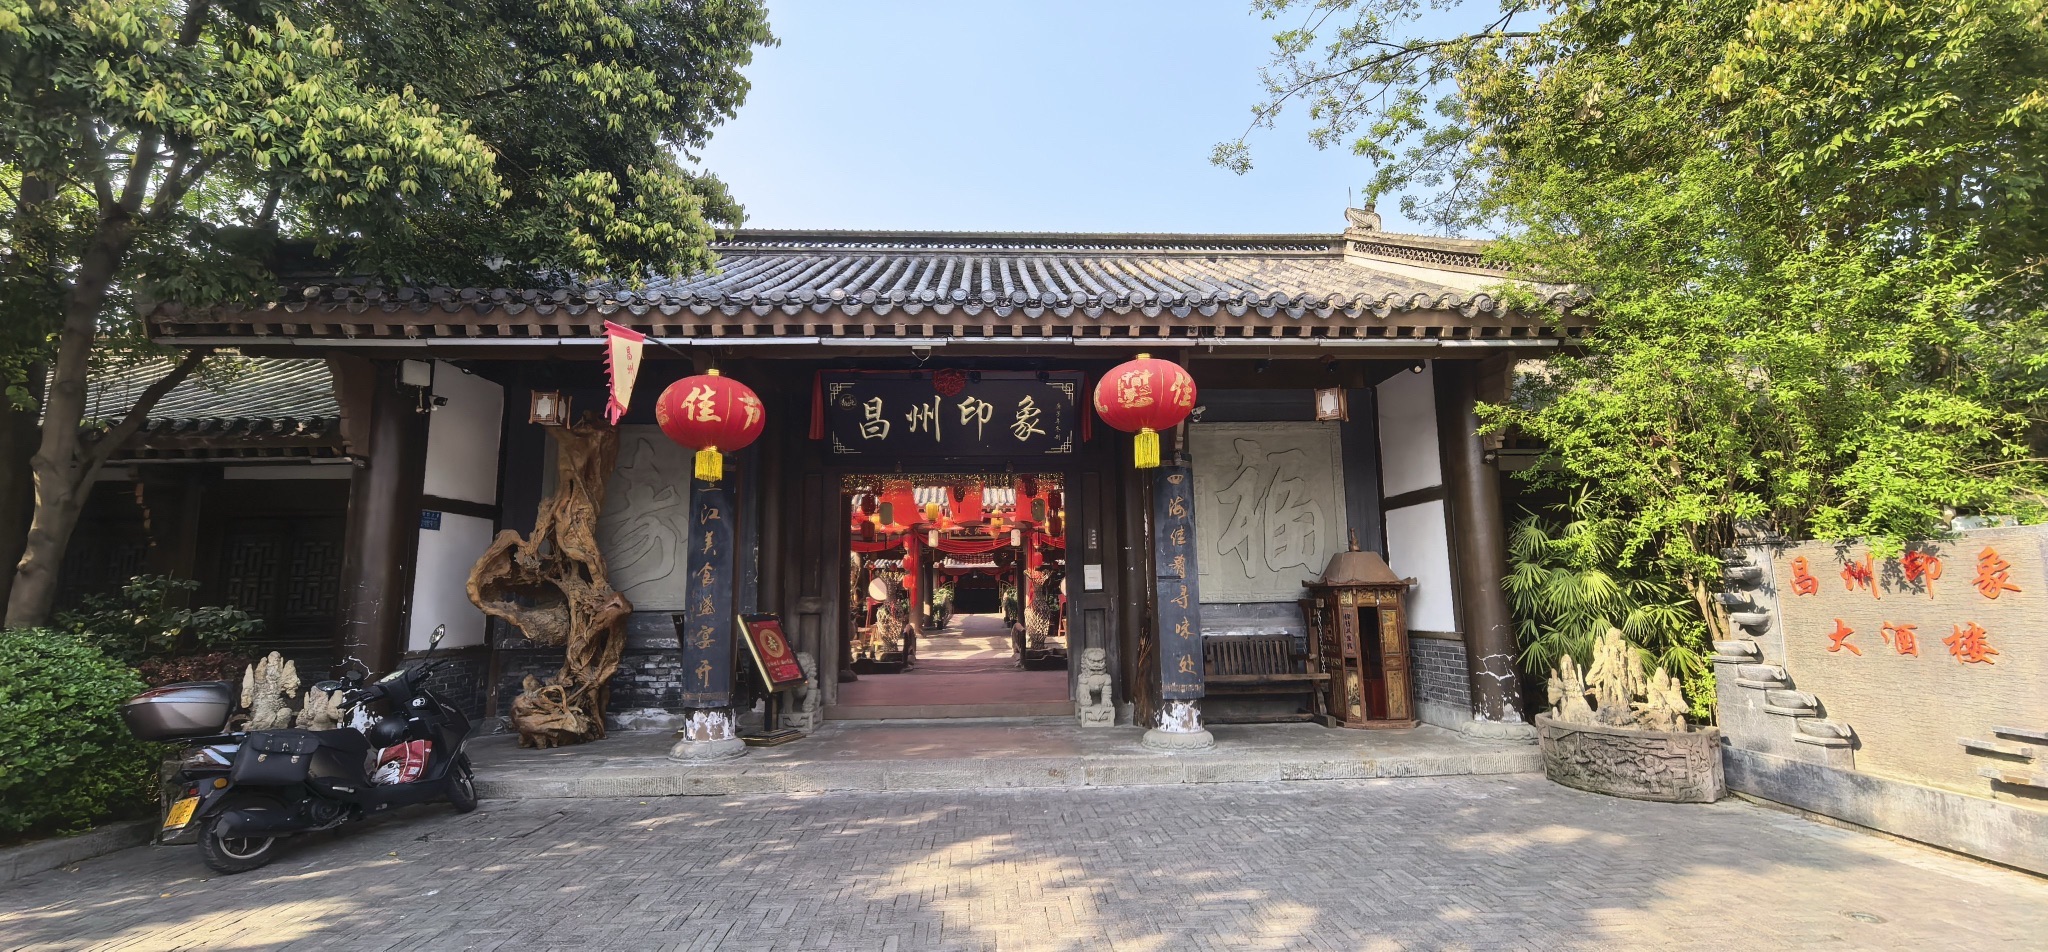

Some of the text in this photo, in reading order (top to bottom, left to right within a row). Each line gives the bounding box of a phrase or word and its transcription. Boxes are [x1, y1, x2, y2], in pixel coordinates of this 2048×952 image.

[859, 395, 1046, 443] 昌州印象
[1789, 546, 2022, 600] 昌州印象
[1827, 618, 1999, 665] 大酒楼
